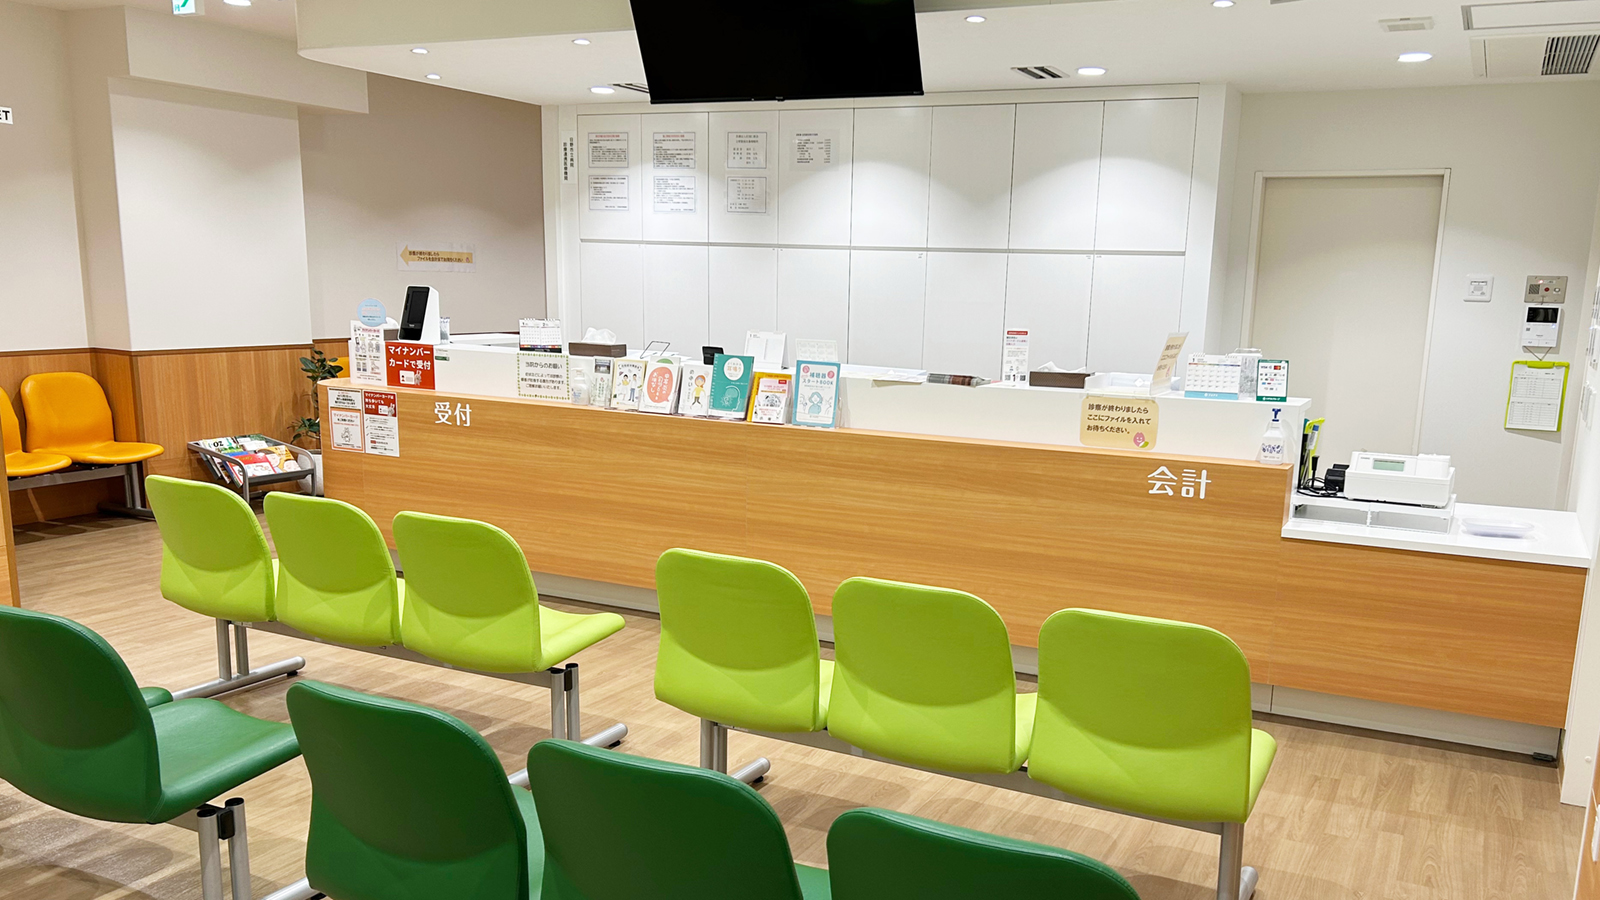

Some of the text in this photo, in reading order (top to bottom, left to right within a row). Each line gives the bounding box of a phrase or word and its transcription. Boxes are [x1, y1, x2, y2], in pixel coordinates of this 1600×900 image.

[388, 346, 431, 357] マイナンバー
[389, 358, 431, 370] カードで受付
[434, 402, 472, 427] 受付
[1088, 403, 1149, 415] 診察が終わりましたら
[1087, 414, 1152, 426] ここにファイルを入れて
[1086, 424, 1131, 435] お待ちください。
[1147, 466, 1212, 500] 会計
